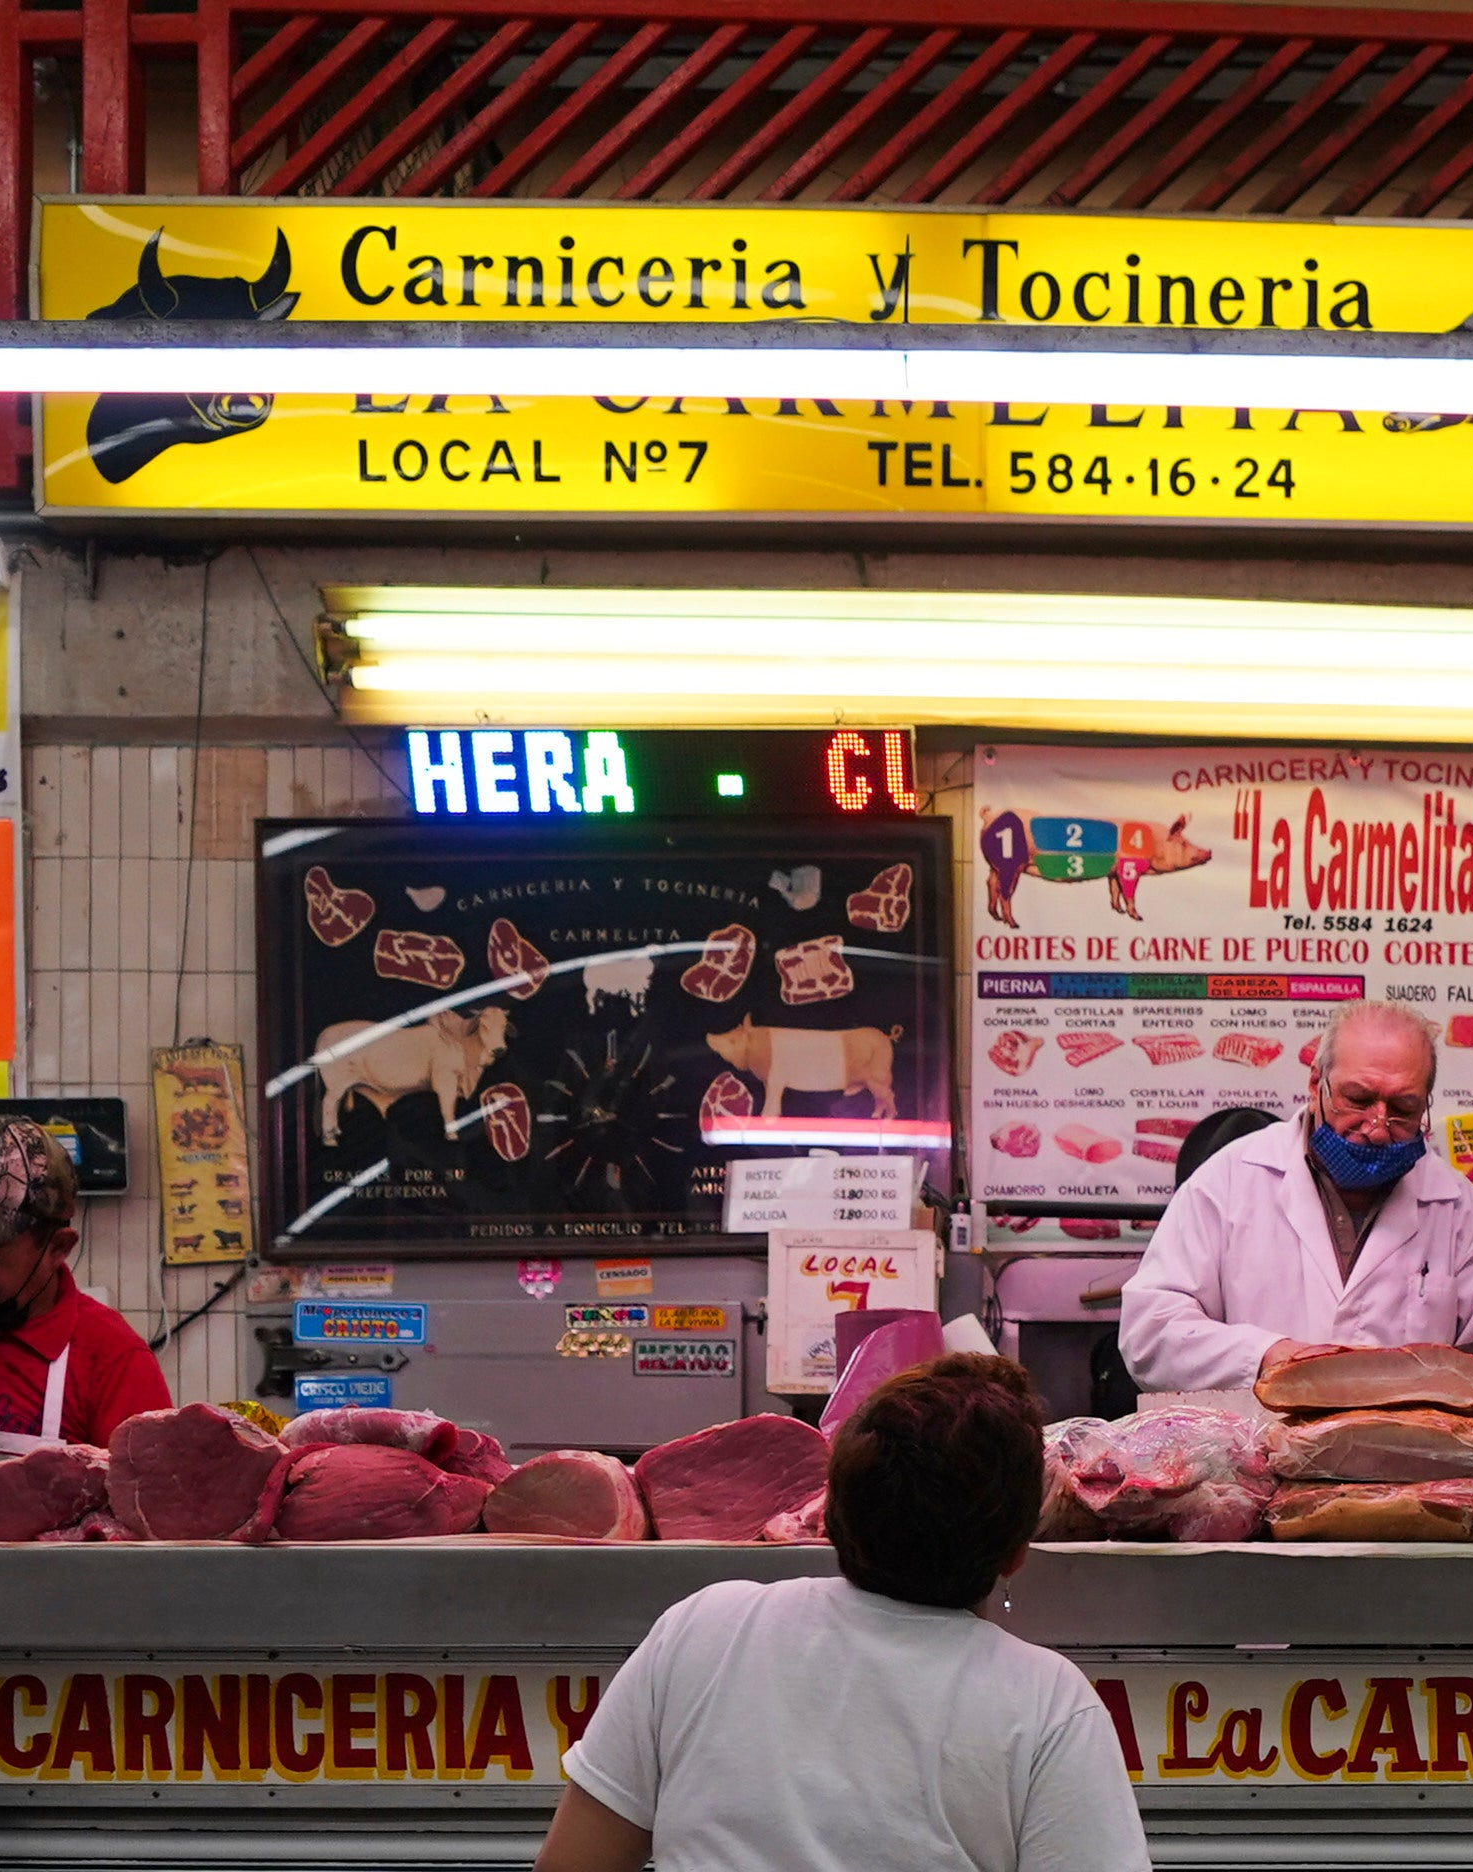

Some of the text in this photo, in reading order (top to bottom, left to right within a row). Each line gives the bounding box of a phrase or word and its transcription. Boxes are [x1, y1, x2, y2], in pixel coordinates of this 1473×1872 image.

[340, 225, 1374, 331] Carniceria y Tocineria
[359, 440, 560, 484] LOCAL
[868, 441, 984, 489] TEL.
[407, 729, 635, 814] HERA
[1359, 757, 1376, 780] Y
[1065, 822, 1083, 848] 2
[1129, 829, 1144, 848] 4
[996, 828, 1014, 860] 1
[1067, 854, 1084, 878] 3
[1123, 860, 1136, 881] 5
[456, 878, 760, 912] CARNICERIA TOCINERIA
[1283, 913, 1434, 933] Tel. 5584 1624
[550, 928, 681, 943] CARMELITA
[976, 936, 1370, 965] CORTES DE CARNE DE PUERCO
[982, 978, 1046, 995] PIERNA
[1212, 978, 1279, 987] CABEZA
[1289, 981, 1360, 995] ESPALDILLA
[1212, 989, 1284, 997] DE LOMO
[1386, 985, 1437, 1002] SUADERO
[995, 1006, 1037, 1016] PIERNA
[1053, 1006, 1124, 1017] COSTILLAS
[1132, 1006, 1204, 1016] SPARERIBS
[1230, 1007, 1268, 1017] LOMO
[983, 1017, 1050, 1027] CON HUESO
[1065, 1019, 1116, 1028] CORTAS
[1142, 1018, 1194, 1028] ENTERO
[1210, 1018, 1239, 1028] CON
[1242, 1018, 1288, 1028] HUESO
[993, 1087, 1038, 1097] PIERNA
[1074, 1087, 1104, 1097] LOMO
[1130, 1088, 1205, 1098] COSTILLAR
[1218, 1088, 1278, 1099] CHULETA
[1006, 1099, 1049, 1109] HUESO
[1053, 1099, 1125, 1109] DESHUESADO
[1158, 1100, 1199, 1109] LOUIS
[1211, 1099, 1285, 1110] RANCHERA
[404, 1168, 433, 1182] POR
[745, 1169, 783, 1181] BISTEC
[983, 1184, 1046, 1196] CHAMORRO
[1058, 1185, 1119, 1196] CHULETA
[742, 1210, 788, 1221] MOLIDA
[470, 1222, 534, 1237] PEDIDOS
[800, 1253, 899, 1279] LOCAL
[598, 1268, 648, 1280] CENSADO
[826, 1280, 870, 1311] 7
[323, 1319, 399, 1339] CRISTO
[1158, 1680, 1279, 1776] La
